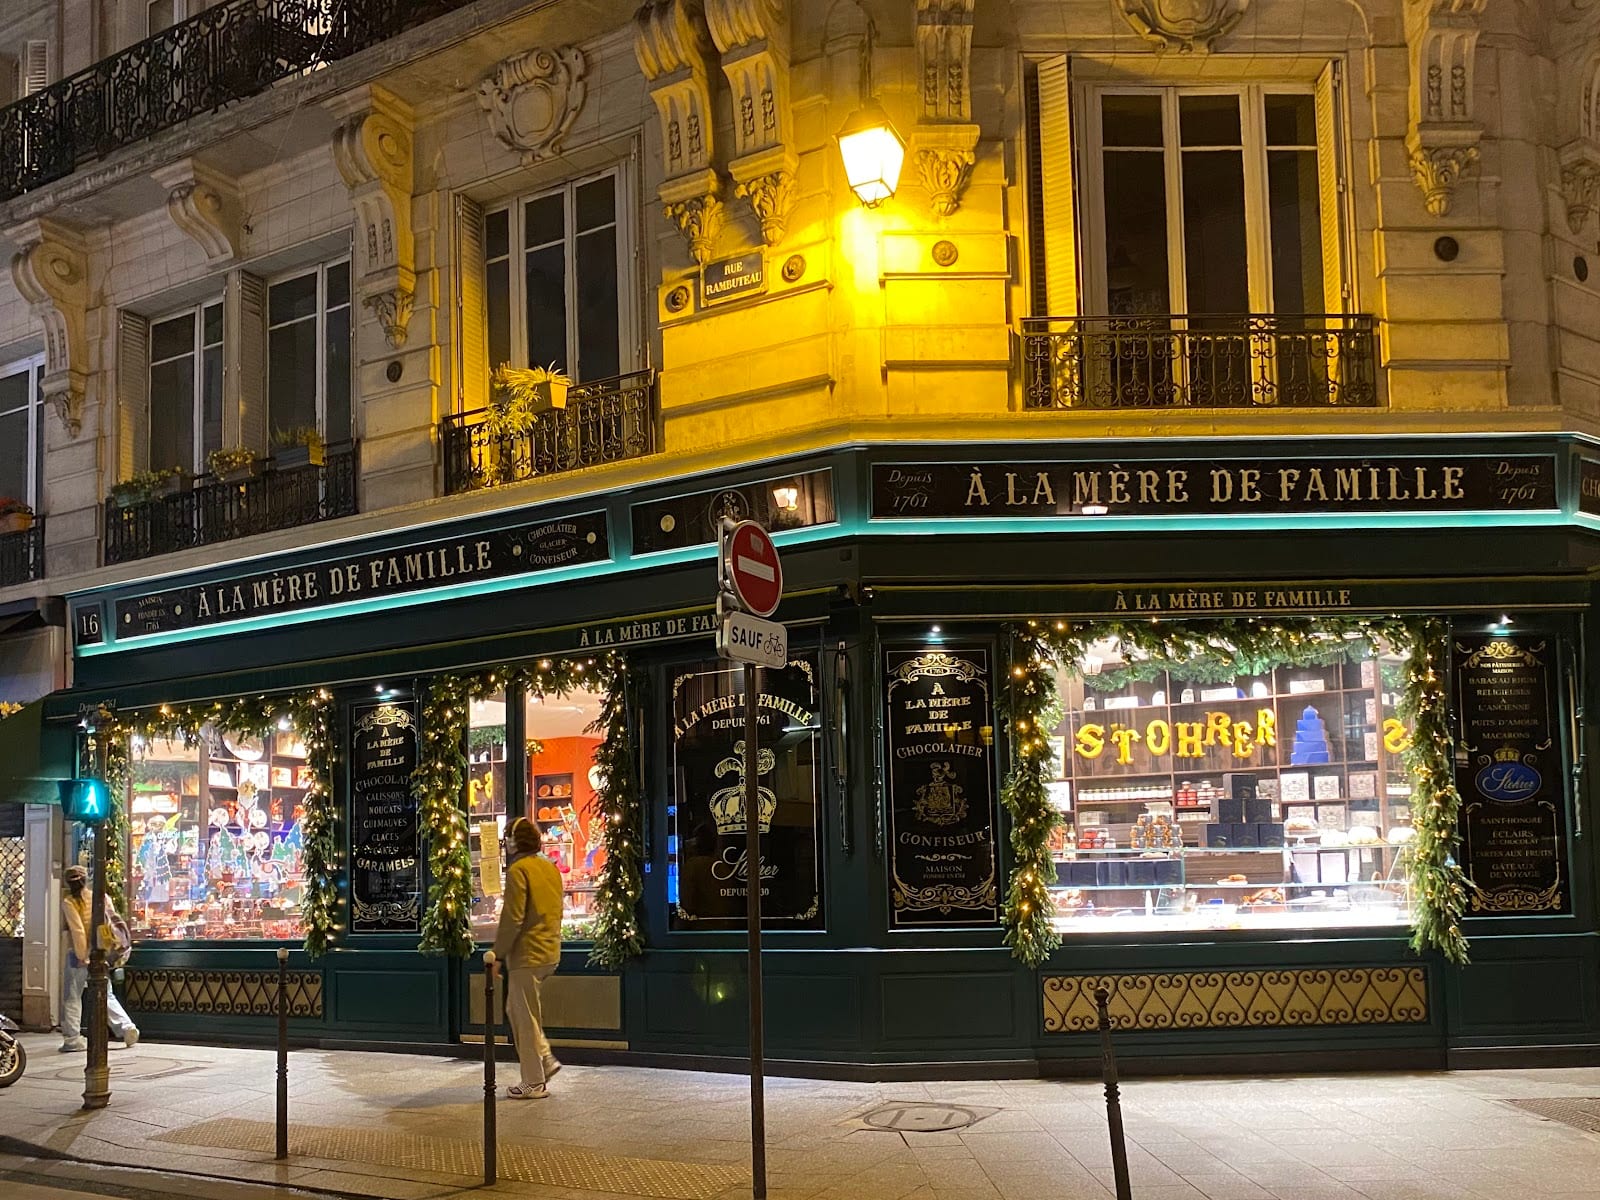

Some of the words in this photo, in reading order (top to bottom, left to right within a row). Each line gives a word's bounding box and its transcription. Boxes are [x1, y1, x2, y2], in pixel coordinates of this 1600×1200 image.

[724, 262, 743, 275] RUE
[706, 272, 762, 295] RAMBUTEAU
[888, 469, 932, 489] Depuis
[1495, 461, 1541, 480] Depuis
[964, 466, 990, 506] À
[1005, 472, 1056, 505] LA
[1073, 463, 1189, 505] MÈRE
[1210, 469, 1261, 502] DE
[1278, 466, 1465, 501] FAMILLE
[893, 492, 928, 512] 1761
[1500, 482, 1538, 505] 1761
[527, 523, 577, 542] CHOCOLATIER
[530, 547, 578, 565] CONFISEUR
[197, 586, 210, 618] À
[217, 584, 245, 614] LA
[253, 571, 317, 608] MÈRE
[329, 564, 361, 594] DE
[370, 541, 492, 588] FAMILLE
[1114, 590, 1128, 609] À
[1135, 594, 1160, 609] LA
[1169, 589, 1223, 608] MÈRE
[1232, 592, 1256, 607] DE
[1264, 590, 1351, 607] FAMILLE
[81, 613, 99, 635] 16
[580, 628, 590, 646] À
[595, 629, 614, 645] LA
[620, 621, 660, 641] MÈRE
[666, 618, 686, 635] DE
[692, 613, 720, 631] FAM
[731, 626, 763, 649] SAUF
[681, 709, 700, 731] LA
[700, 694, 736, 718] MÈRE
[757, 693, 813, 726] FAMILLE
[905, 699, 927, 710] LA
[757, 715, 771, 726] 761
[928, 710, 949, 720] DE
[905, 720, 972, 735] FAMILLE
[366, 740, 379, 750] LA
[1075, 708, 1276, 765] STOHRER
[380, 749, 392, 757] DE
[896, 743, 983, 759] CHOCOLATIER
[366, 756, 405, 770] FAMILLE
[355, 774, 414, 792] CHOCOLAT
[366, 791, 404, 802] CALISSONS
[369, 805, 402, 815] NOUGATS
[363, 818, 407, 829] GUIMAUVES
[900, 830, 987, 847] CONFISEUR
[356, 855, 415, 872] CARAMELS
[925, 865, 963, 873] MAISON
[758, 888, 770, 896] 30
